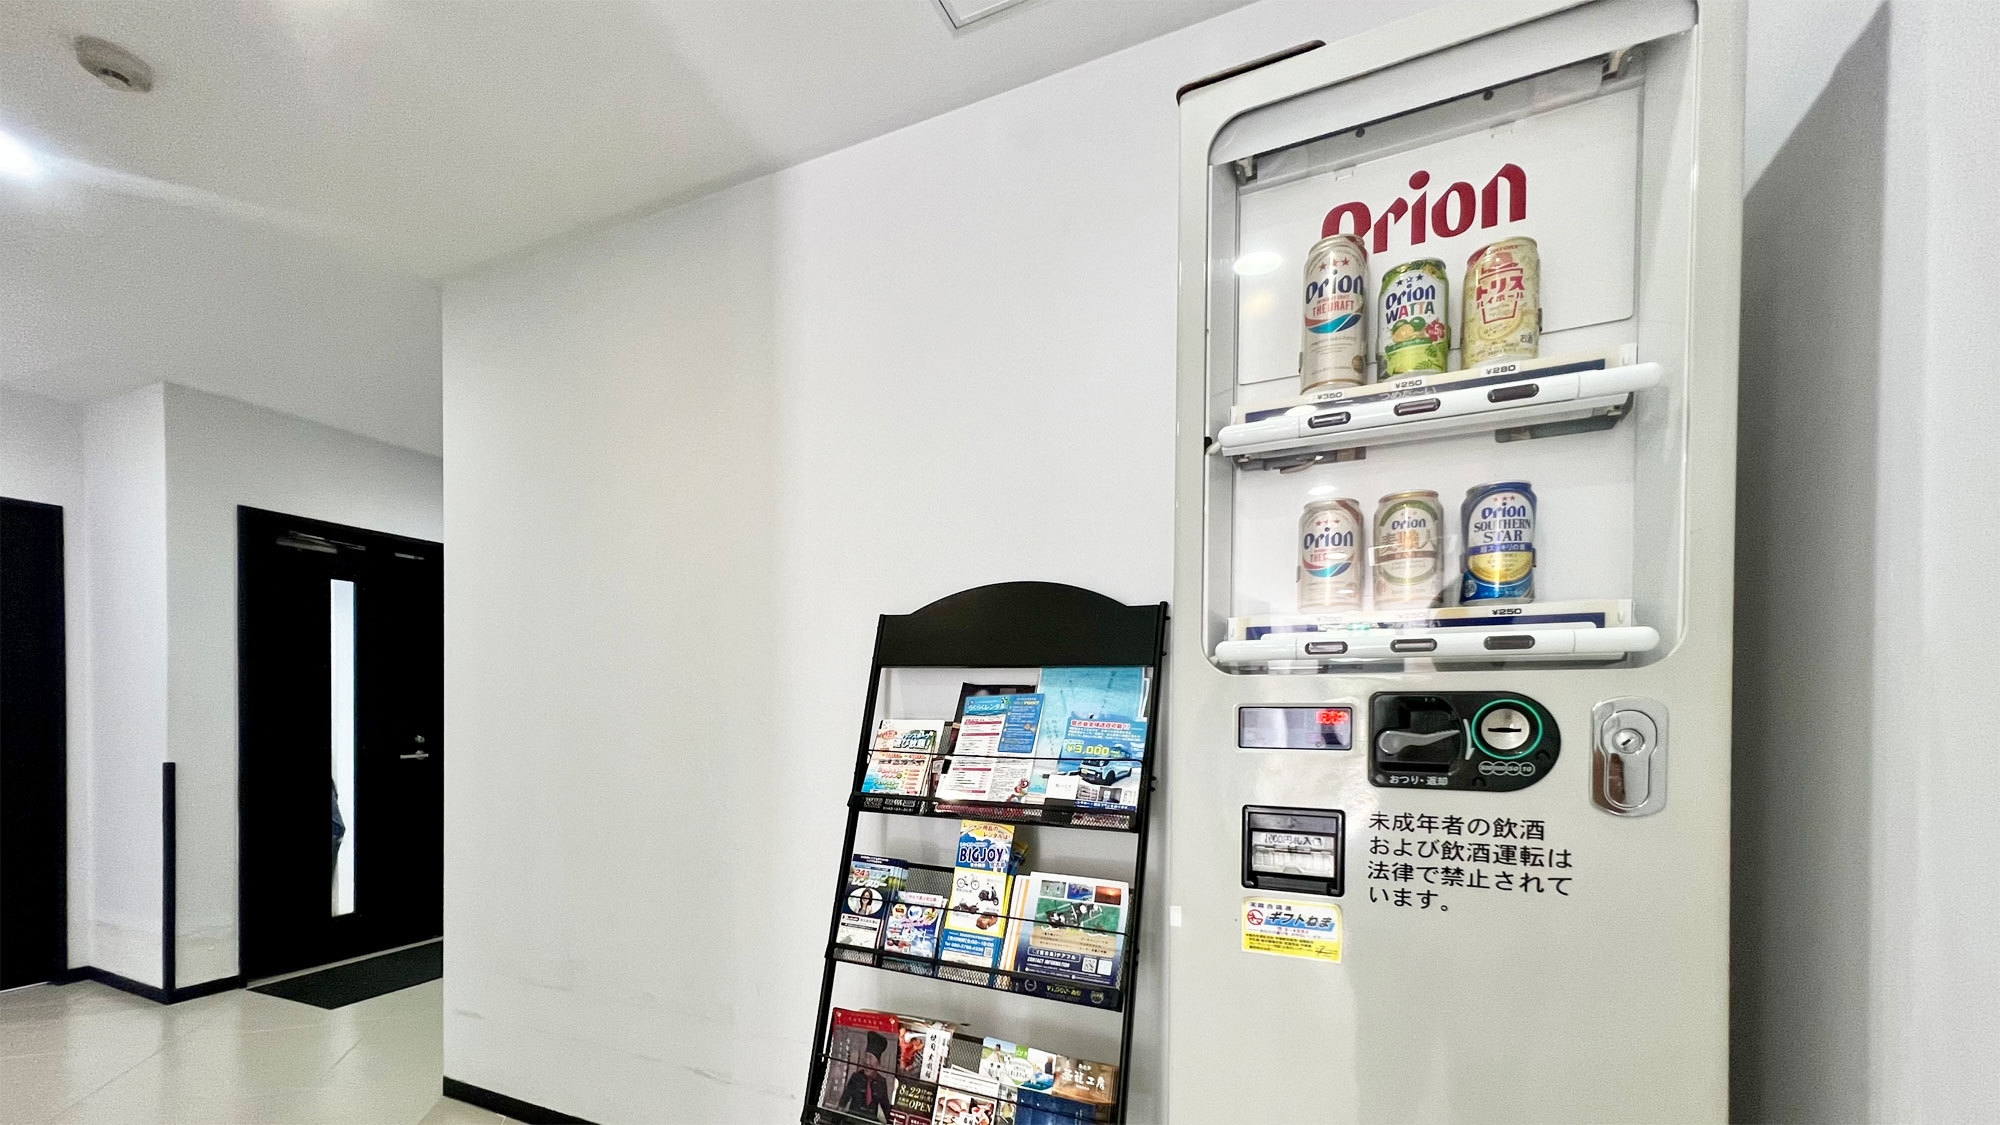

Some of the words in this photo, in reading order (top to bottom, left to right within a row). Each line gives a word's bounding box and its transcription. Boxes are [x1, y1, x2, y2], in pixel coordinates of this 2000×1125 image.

[1321, 162, 1527, 255] Orion
[1305, 269, 1364, 304] Orion
[1385, 284, 1436, 310] Orion
[1476, 275, 1525, 302] トリス
[1385, 301, 1435, 325] WATTA
[1486, 364, 1516, 375] ¥280
[1395, 379, 1423, 389] ¥250
[1317, 391, 1343, 400] ¥350
[1481, 501, 1526, 520] Orion
[1391, 516, 1426, 531] Orion
[1303, 527, 1354, 550] Orion
[1483, 529, 1523, 544] STAR
[1491, 608, 1523, 616] ¥250
[1389, 775, 1449, 787] おつり・返却
[1368, 811, 1545, 841] 未成年者の飲酒
[1369, 836, 1573, 869] および飲酒運転は
[1367, 860, 1573, 896] 法律で禁止されて
[1369, 886, 1448, 912] います。
[1269, 911, 1332, 928] ギフトねま
[908, 1099, 933, 1113] OPEN
